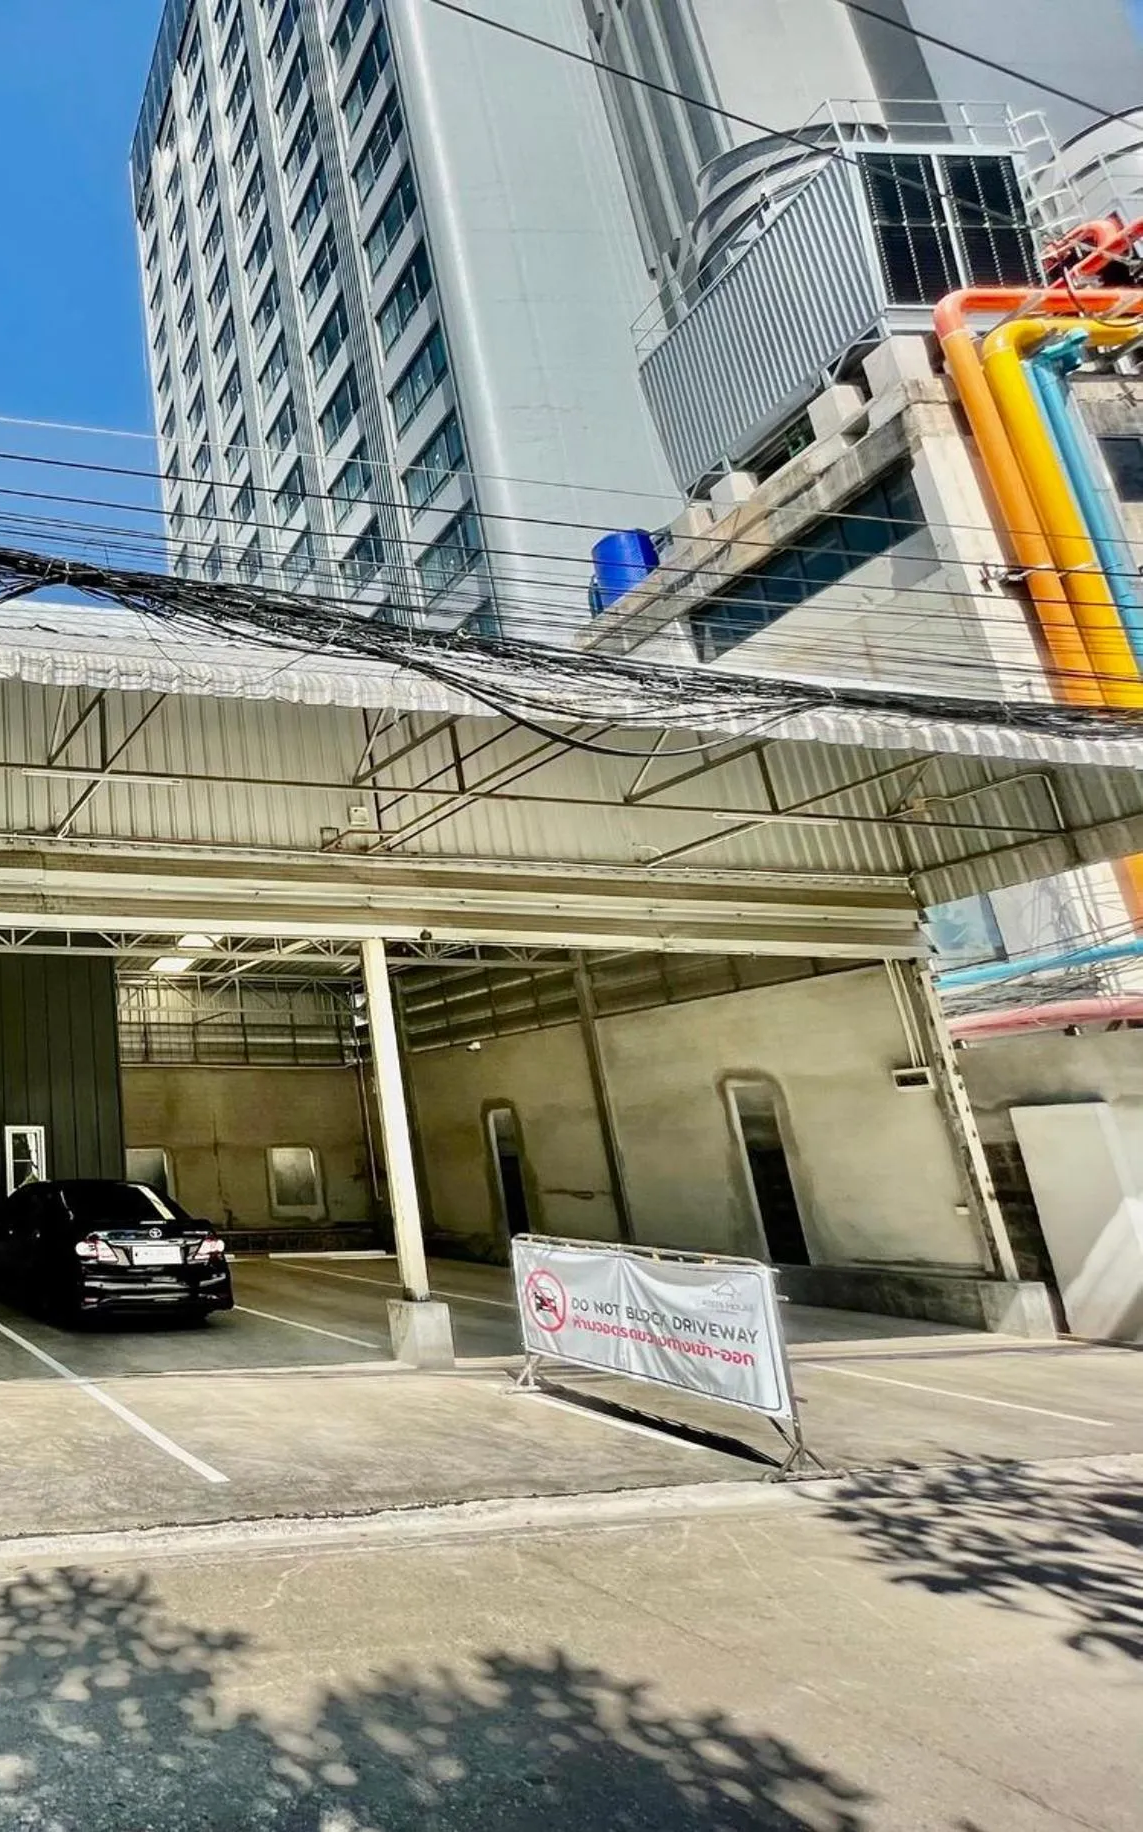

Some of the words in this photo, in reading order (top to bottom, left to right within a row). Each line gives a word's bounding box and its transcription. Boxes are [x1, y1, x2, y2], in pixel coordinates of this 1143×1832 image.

[571, 1297, 590, 1312] DO
[593, 1301, 620, 1316] NOT
[625, 1306, 667, 1327] BLOCK
[672, 1316, 759, 1344] DRIVEWAY
